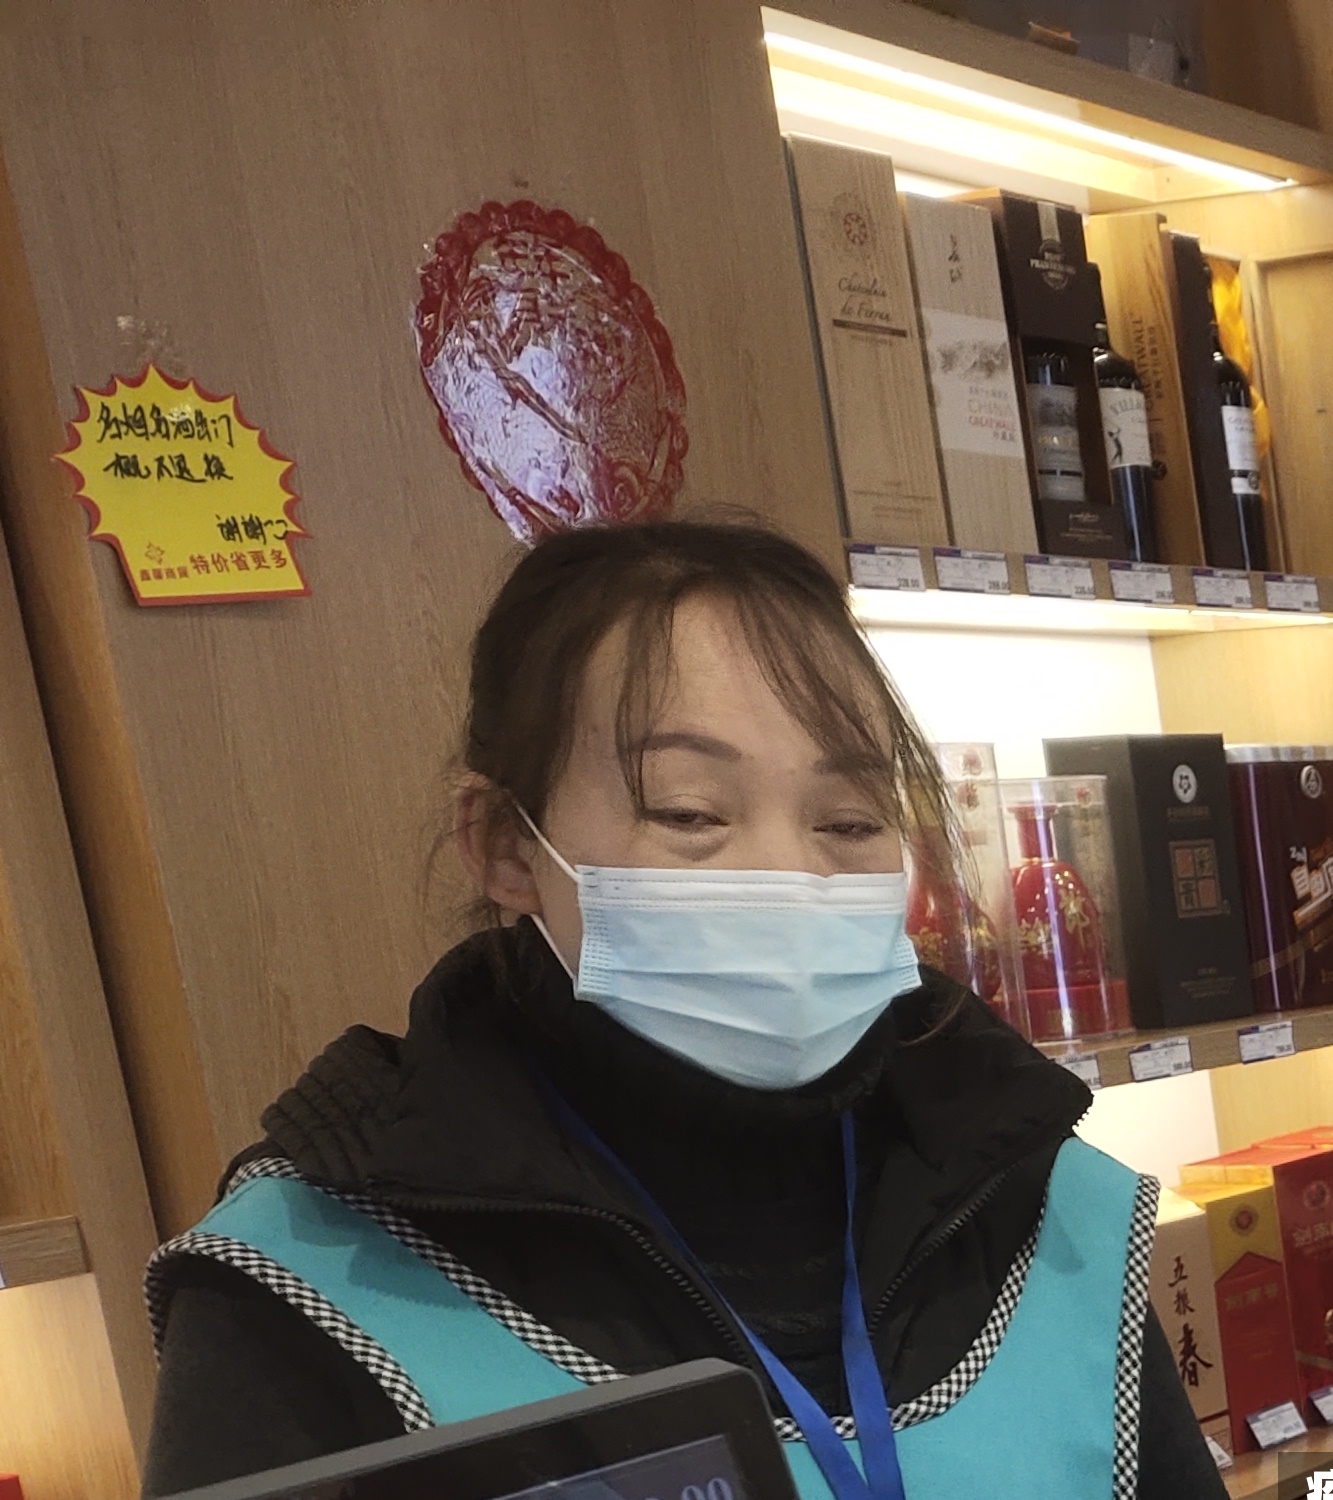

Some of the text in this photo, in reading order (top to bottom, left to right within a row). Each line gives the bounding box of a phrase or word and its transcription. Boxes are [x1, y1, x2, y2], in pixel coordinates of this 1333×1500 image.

[189, 549, 287, 574] 特价省更多
[1167, 1255, 1214, 1387] 五粮春
